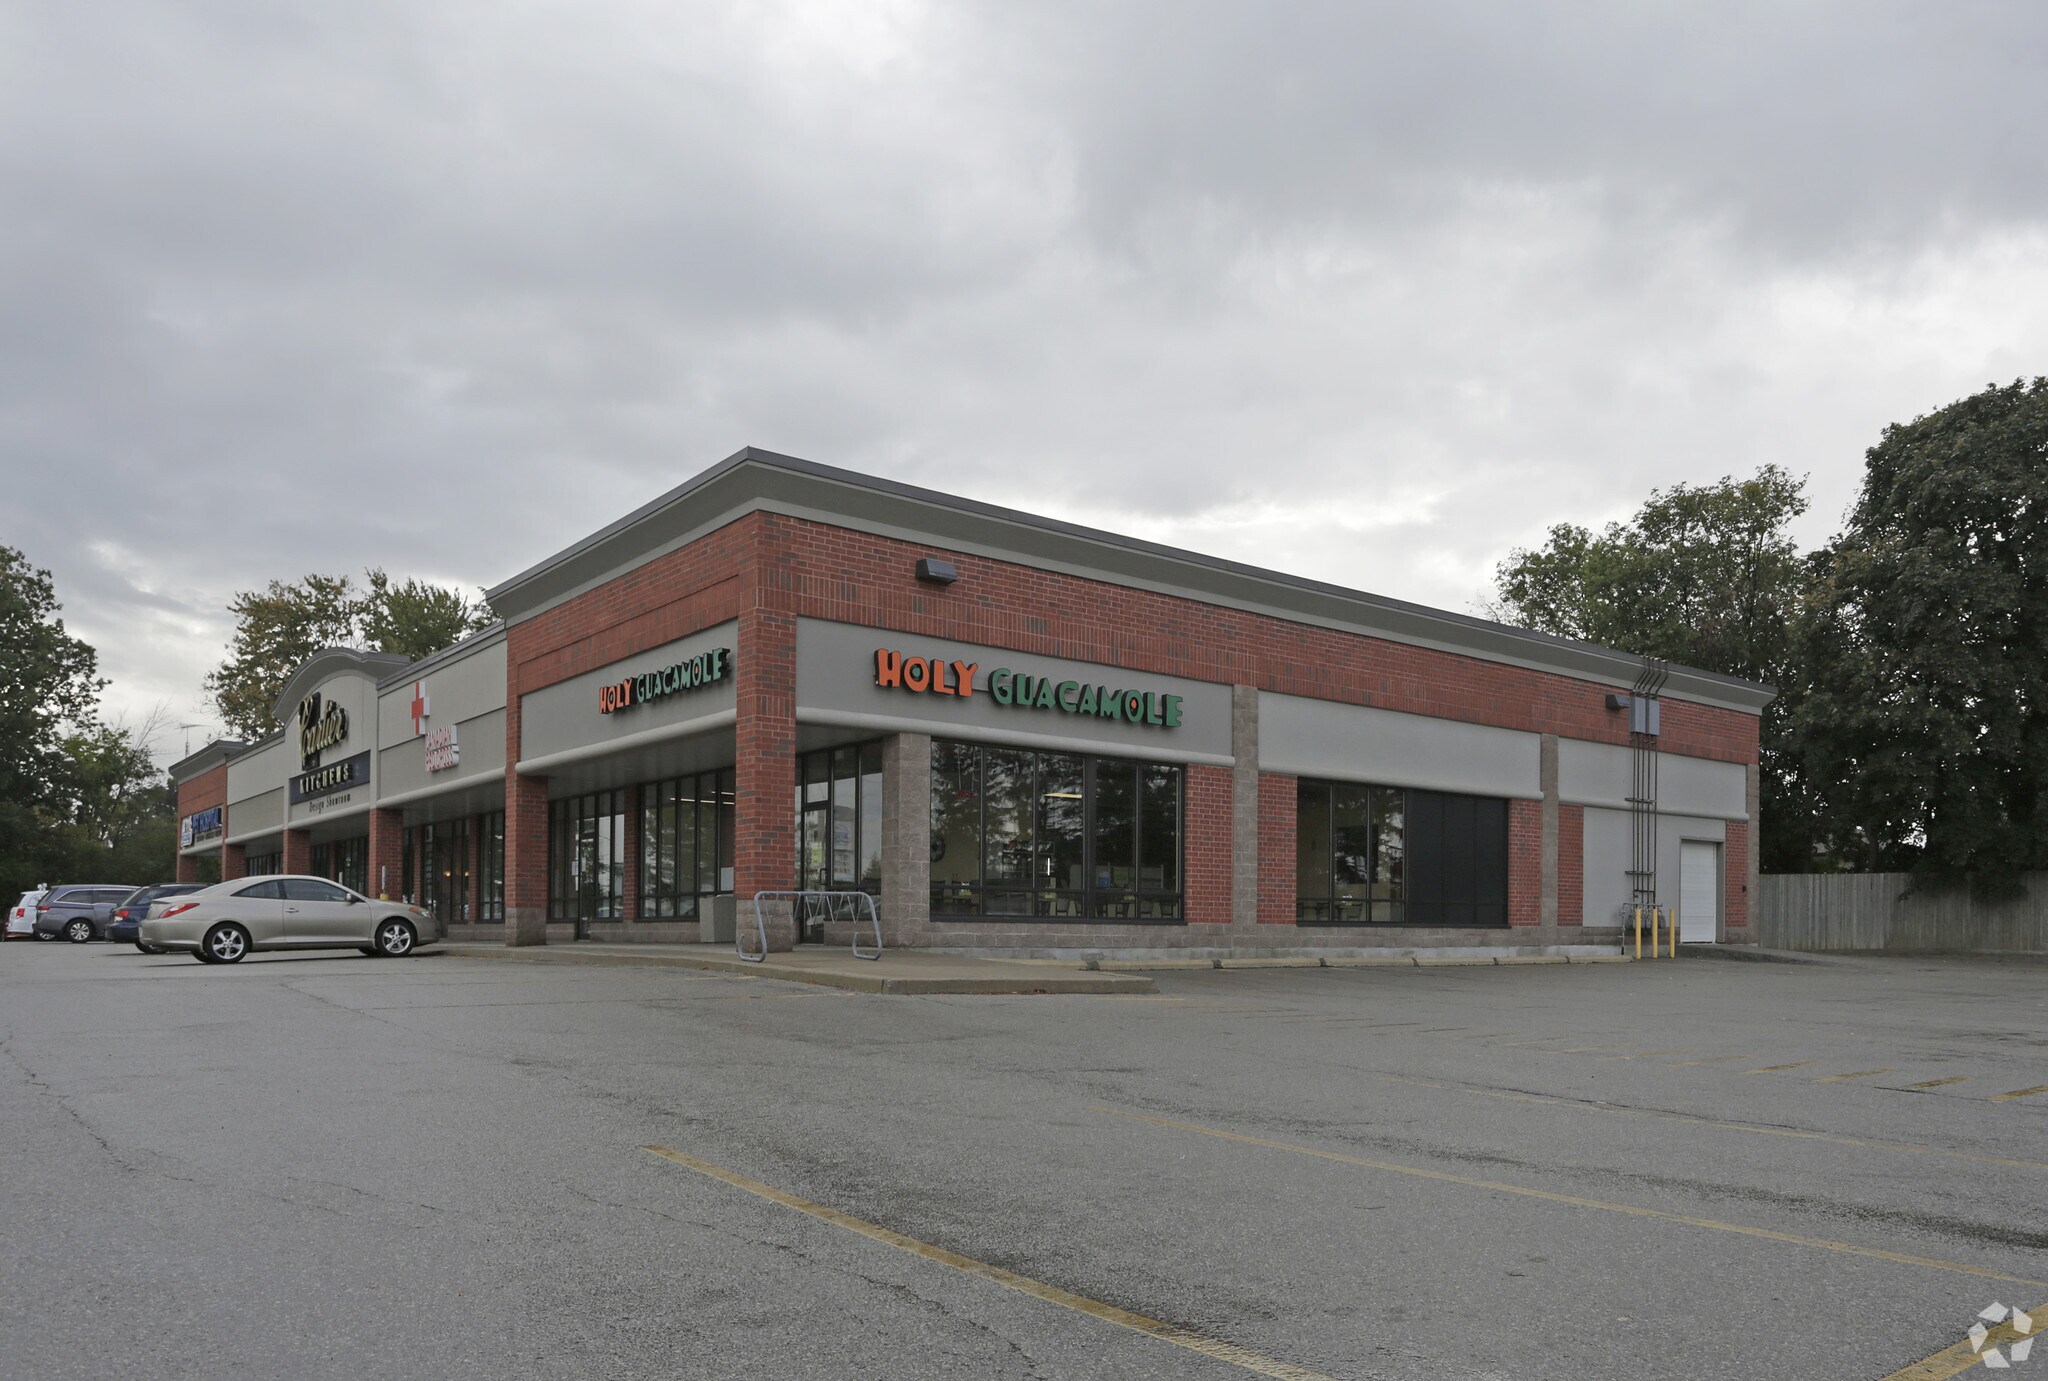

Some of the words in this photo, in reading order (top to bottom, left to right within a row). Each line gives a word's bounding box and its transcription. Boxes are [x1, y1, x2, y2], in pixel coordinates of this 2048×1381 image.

[599, 677, 634, 714] HOLY
[636, 648, 729, 703] GUACAMOLE
[873, 648, 978, 697] HOLY
[987, 668, 1184, 727] GUACAMOLE
[300, 763, 349, 794] KITCHENS
[309, 800, 325, 814] Design
[326, 794, 351, 808] Showroom
